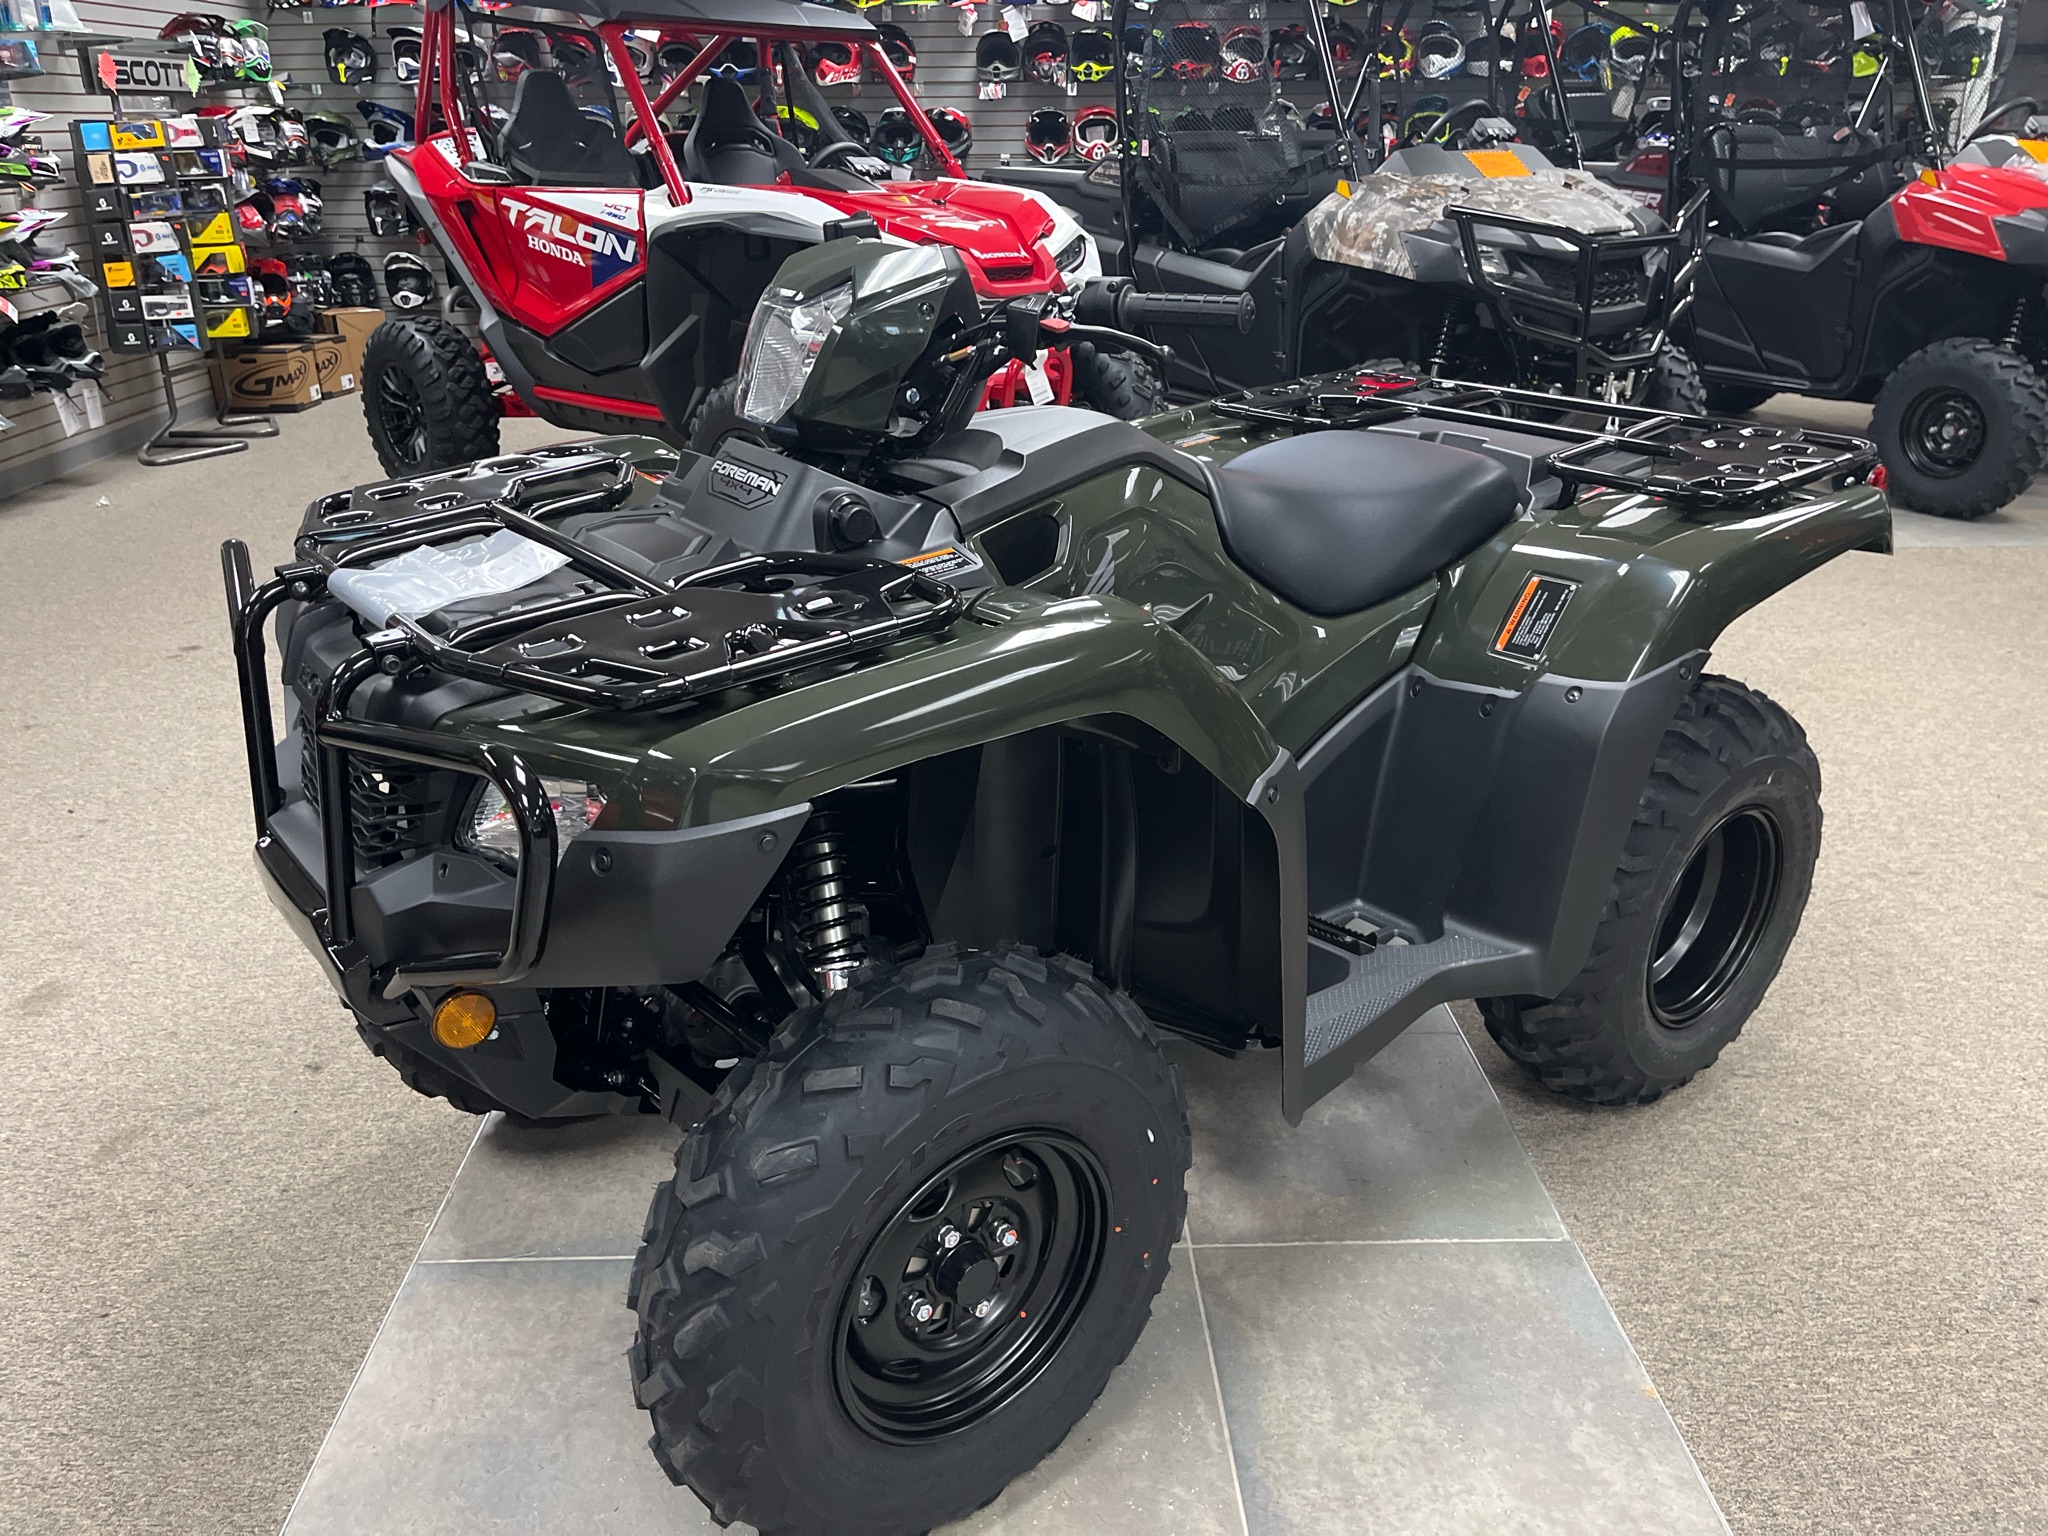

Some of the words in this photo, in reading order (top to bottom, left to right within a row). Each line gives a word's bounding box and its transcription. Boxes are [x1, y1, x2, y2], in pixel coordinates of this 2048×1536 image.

[114, 60, 184, 87] SCOTT
[501, 197, 636, 263] TALON
[527, 233, 587, 268] HONDA
[979, 250, 1024, 260] HONDA
[711, 460, 782, 496] FOREMAN
[1508, 592, 1531, 627] WARNING
